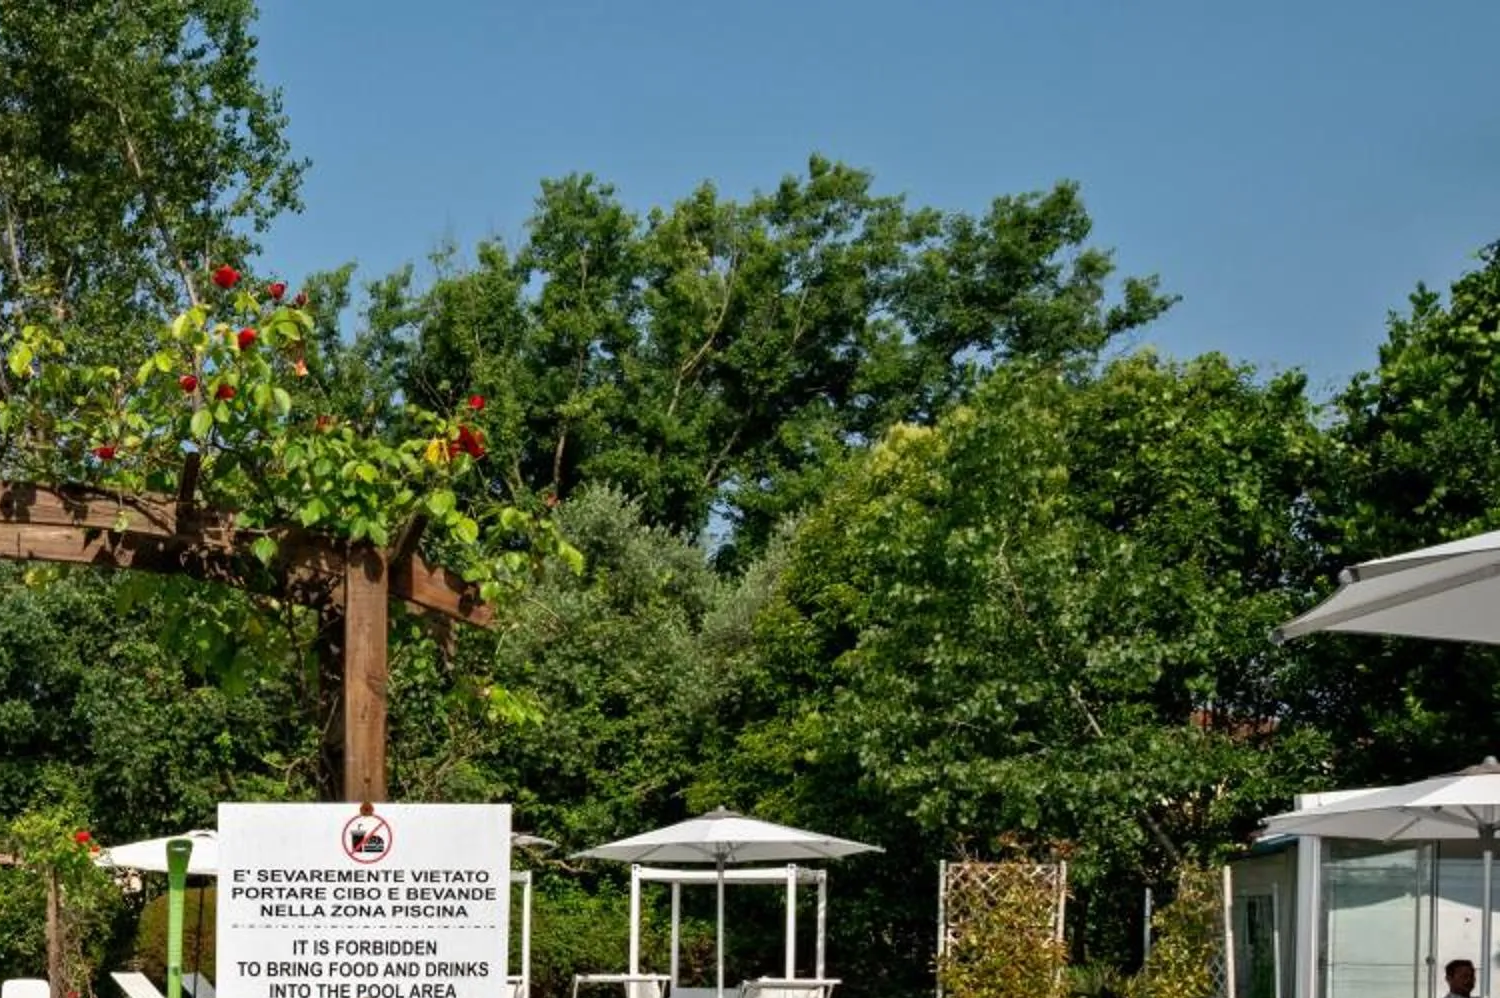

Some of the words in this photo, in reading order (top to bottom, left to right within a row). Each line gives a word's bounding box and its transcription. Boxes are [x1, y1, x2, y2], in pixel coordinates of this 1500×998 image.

[233, 869, 251, 883] E'
[257, 869, 405, 883] SEVAREMENTE
[411, 869, 490, 883] VIETATO
[232, 887, 327, 901] PORTARE
[333, 886, 382, 901] CIBO
[388, 887, 400, 900] E
[406, 886, 497, 901] BEVANDE
[261, 904, 326, 918] NELLA
[331, 904, 387, 918] ZONA
[392, 904, 469, 918] PISCINA
[293, 940, 309, 956] IT
[314, 940, 330, 956] IS
[336, 940, 437, 956] FORBIDDEN
[238, 962, 261, 977] TO
[267, 962, 323, 977] BRING
[329, 962, 379, 977] FOOD
[384, 962, 421, 977] AND
[426, 961, 489, 977] DRINKS
[270, 984, 312, 998] INTO
[316, 984, 351, 998] THE
[357, 984, 405, 998] POOL
[409, 983, 457, 998] AREA
